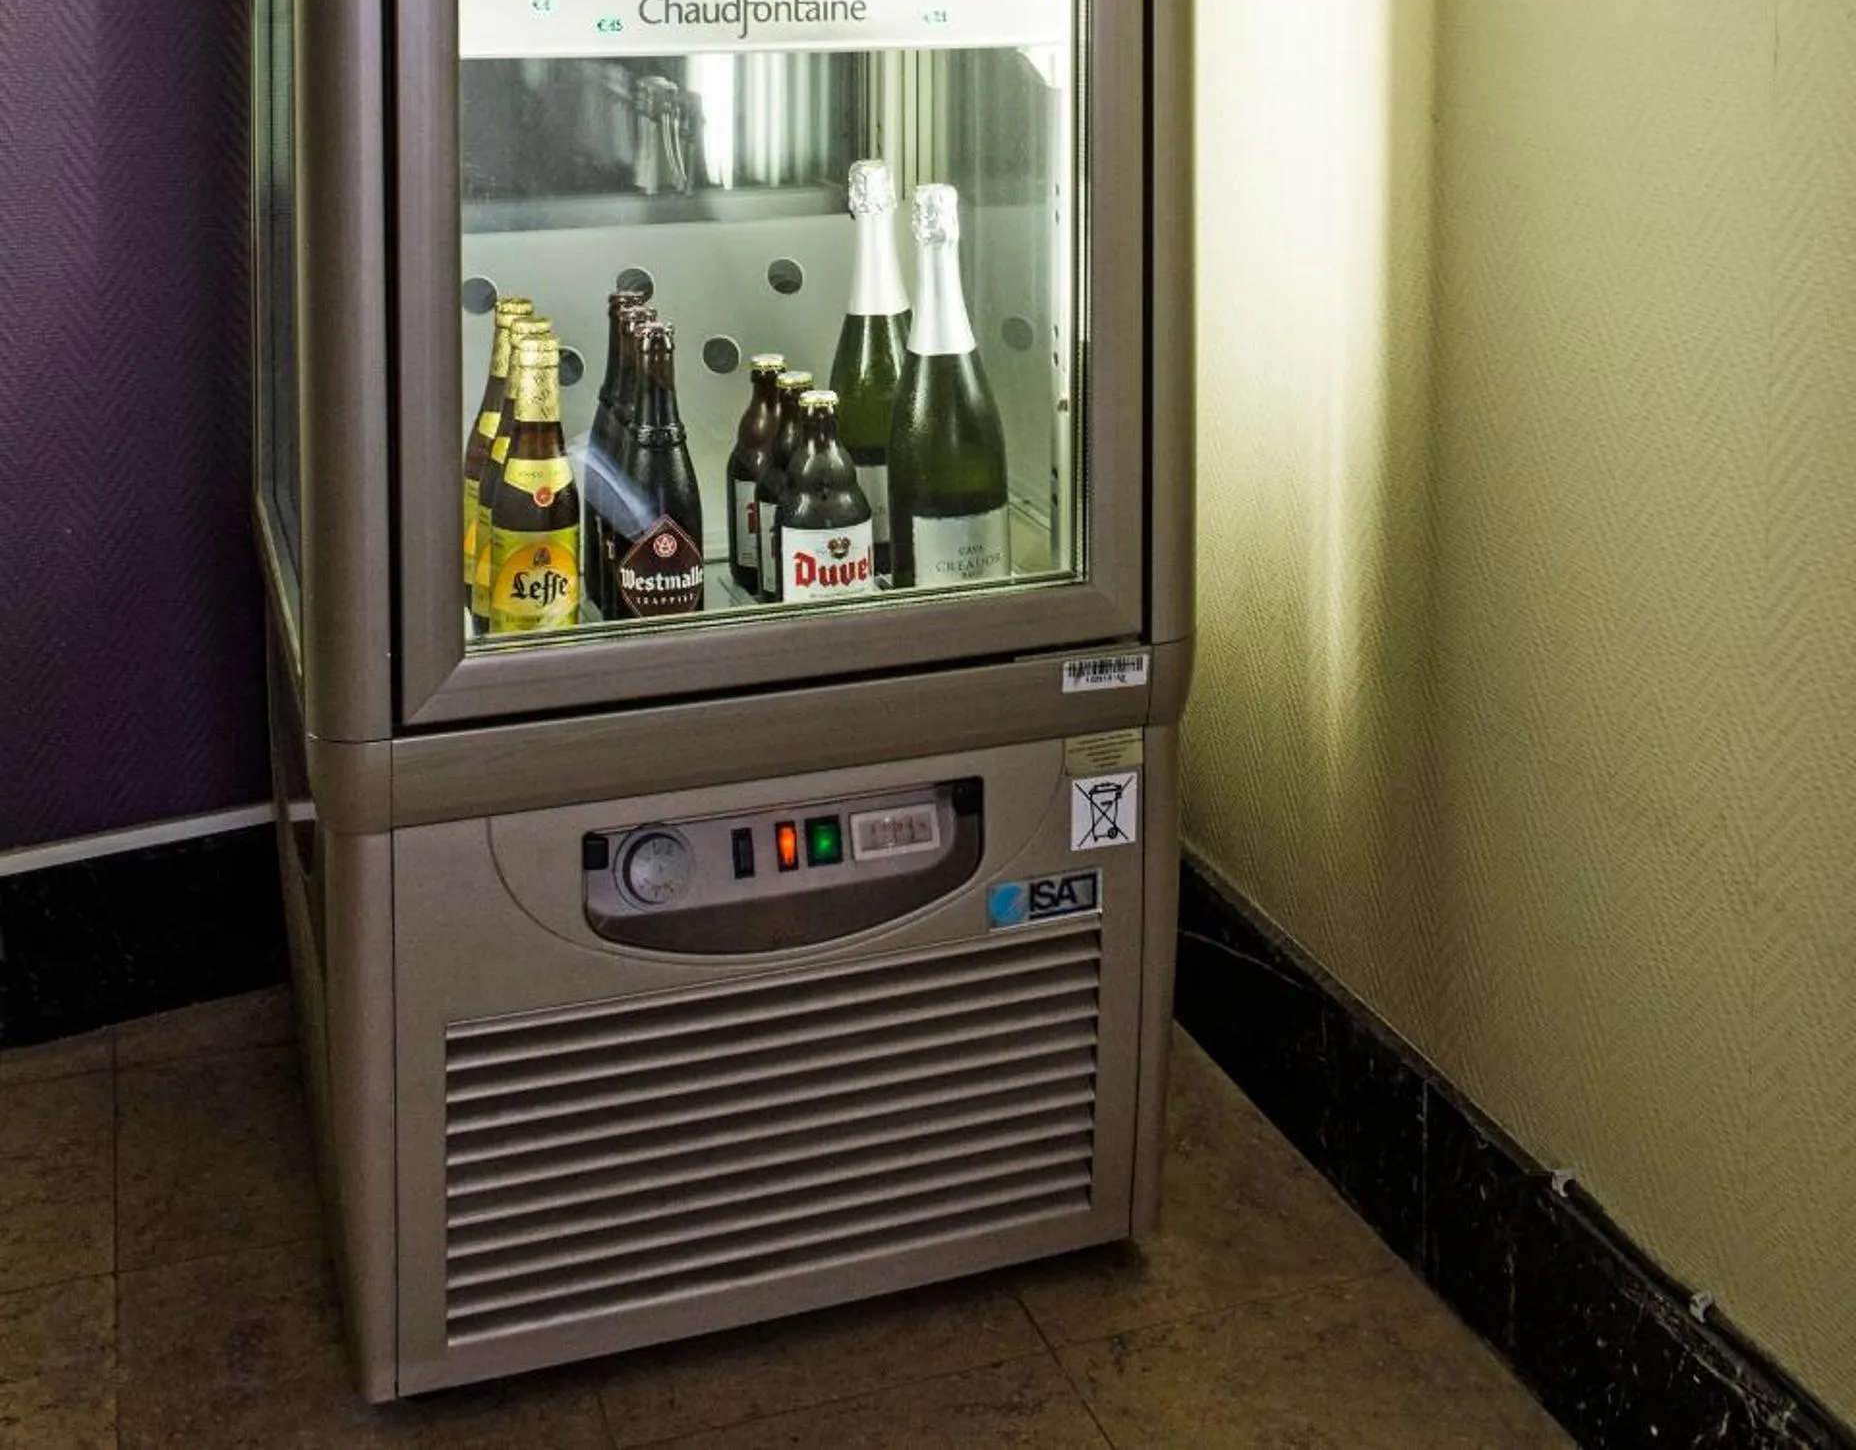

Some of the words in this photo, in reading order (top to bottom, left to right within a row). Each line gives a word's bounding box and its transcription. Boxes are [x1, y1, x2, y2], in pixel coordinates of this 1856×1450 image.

[619, 564, 704, 593] Westmalle
[793, 544, 873, 588] Duvel
[510, 569, 569, 606] Leffe
[1028, 876, 1078, 911] ISA
